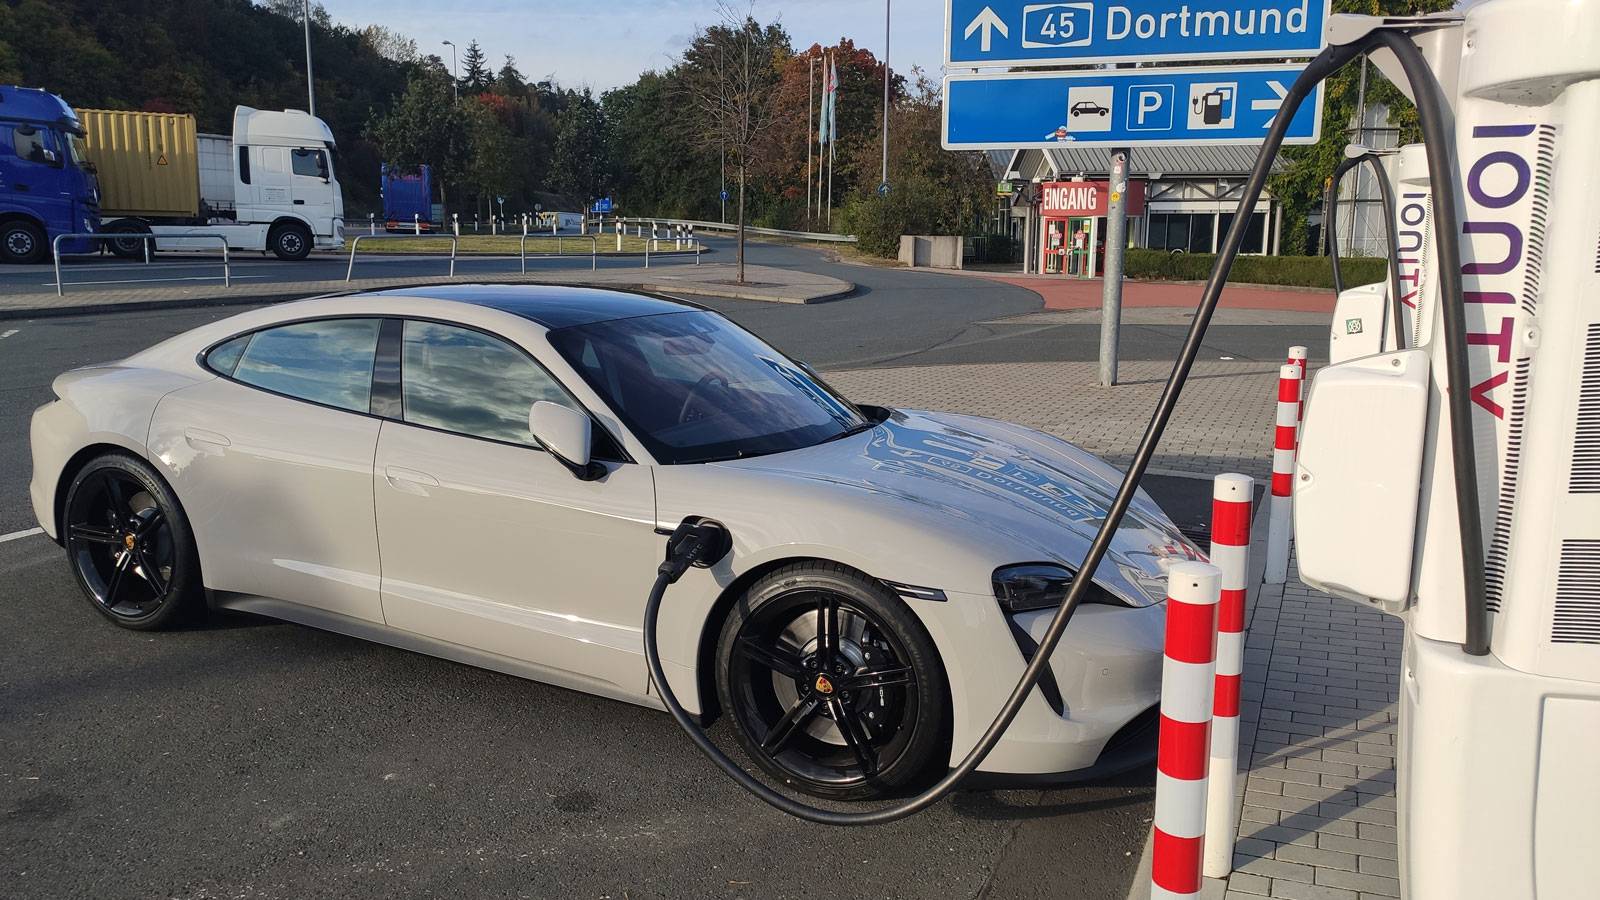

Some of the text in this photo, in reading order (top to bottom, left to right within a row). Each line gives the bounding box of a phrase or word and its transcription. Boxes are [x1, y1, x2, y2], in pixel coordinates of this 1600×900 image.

[1040, 0, 1307, 40] 45 Dortmund
[1137, 91, 1163, 125] P
[1044, 187, 1097, 210] EINGANG
[1461, 123, 1537, 421] IONITY
